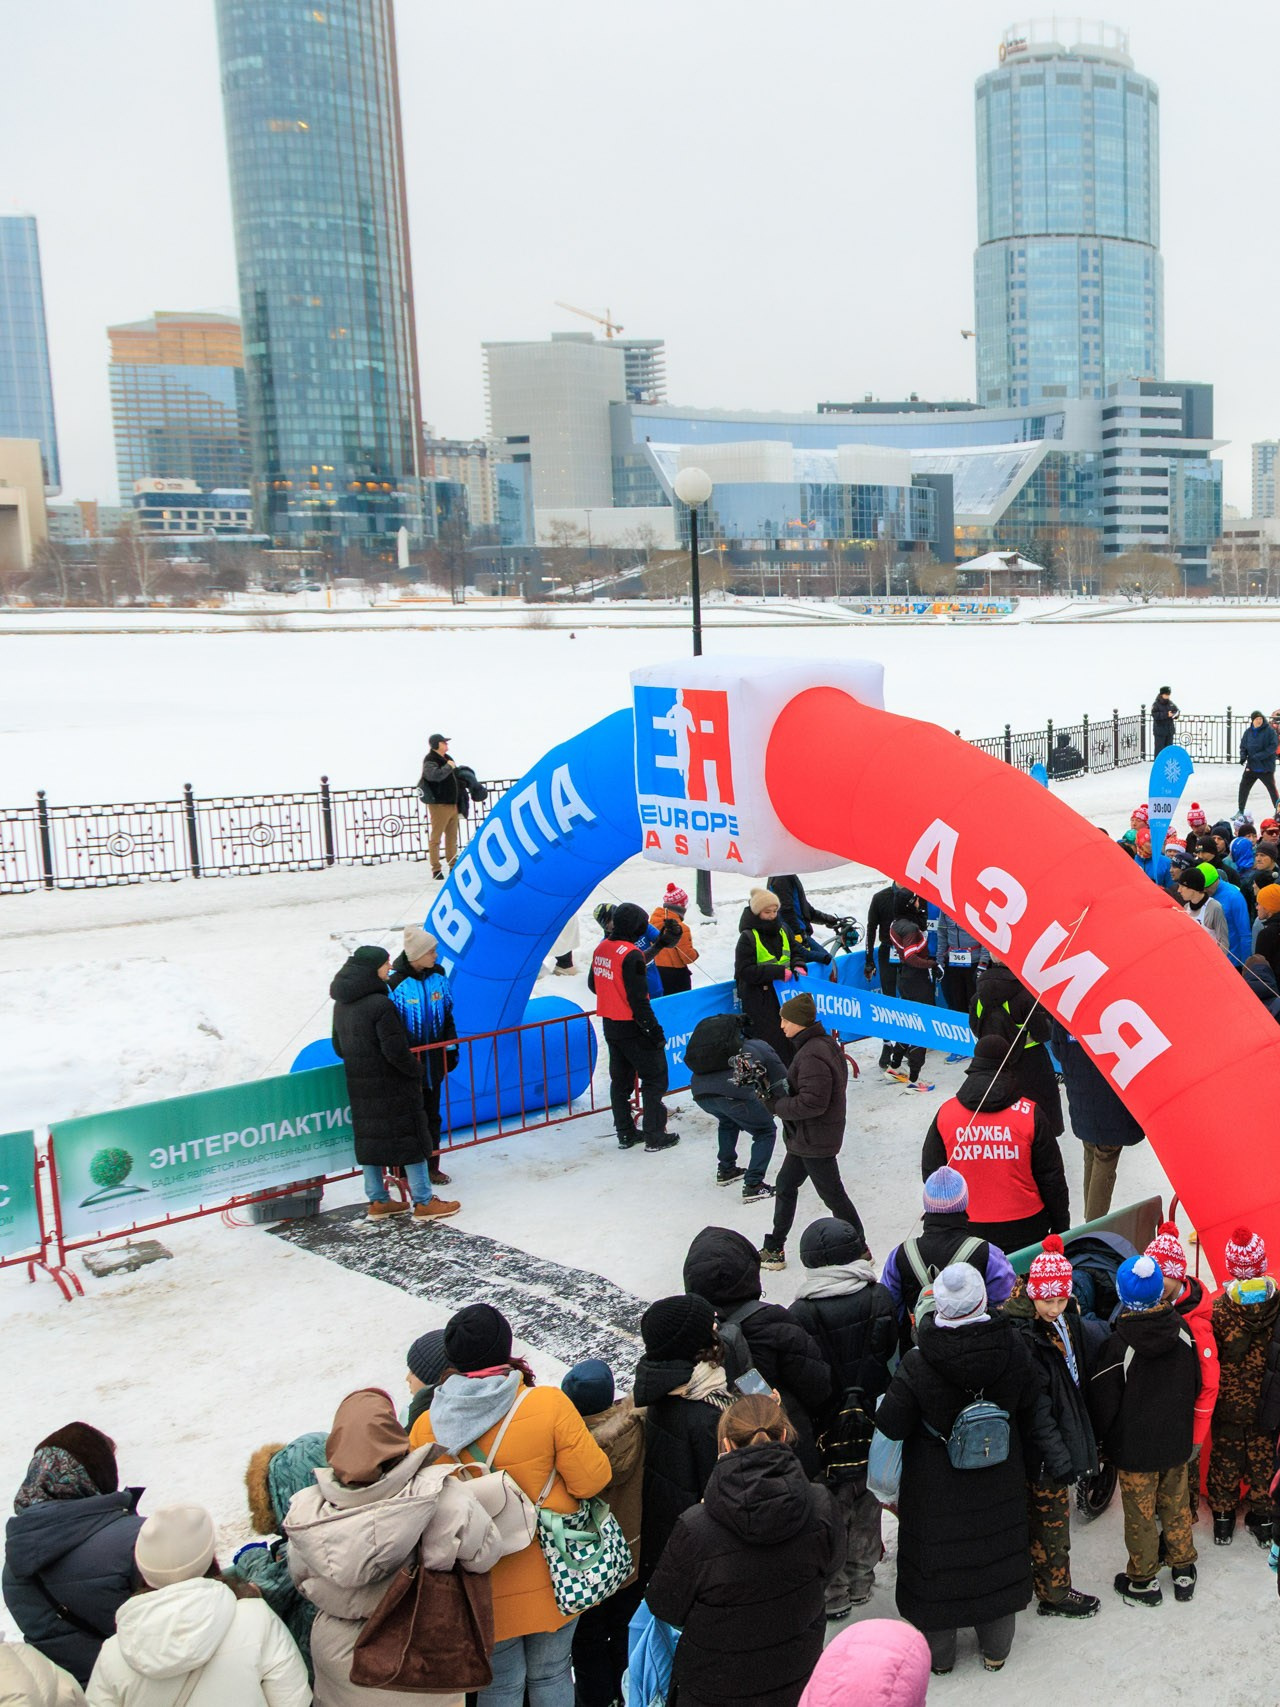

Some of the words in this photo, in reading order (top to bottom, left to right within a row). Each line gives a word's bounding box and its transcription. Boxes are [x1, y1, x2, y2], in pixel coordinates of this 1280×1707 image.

[640, 804, 739, 836] EUROPE
[1153, 803, 1171, 813] 30:00
[431, 763, 597, 978] ВРОПА
[905, 818, 1172, 1091] АЗИЯ
[781, 989, 861, 1018] ГДСКОЙ
[870, 1004, 926, 1032] ЗИМНИЙ
[956, 1126, 1012, 1142] СЛУЖБА
[187, 1162, 235, 1179] ЯВЛЯЕТСЯ
[236, 1145, 312, 1168] ЛЕКАРСТВЕННЫМ
[953, 1144, 1019, 1160] ОХРАНЫ
